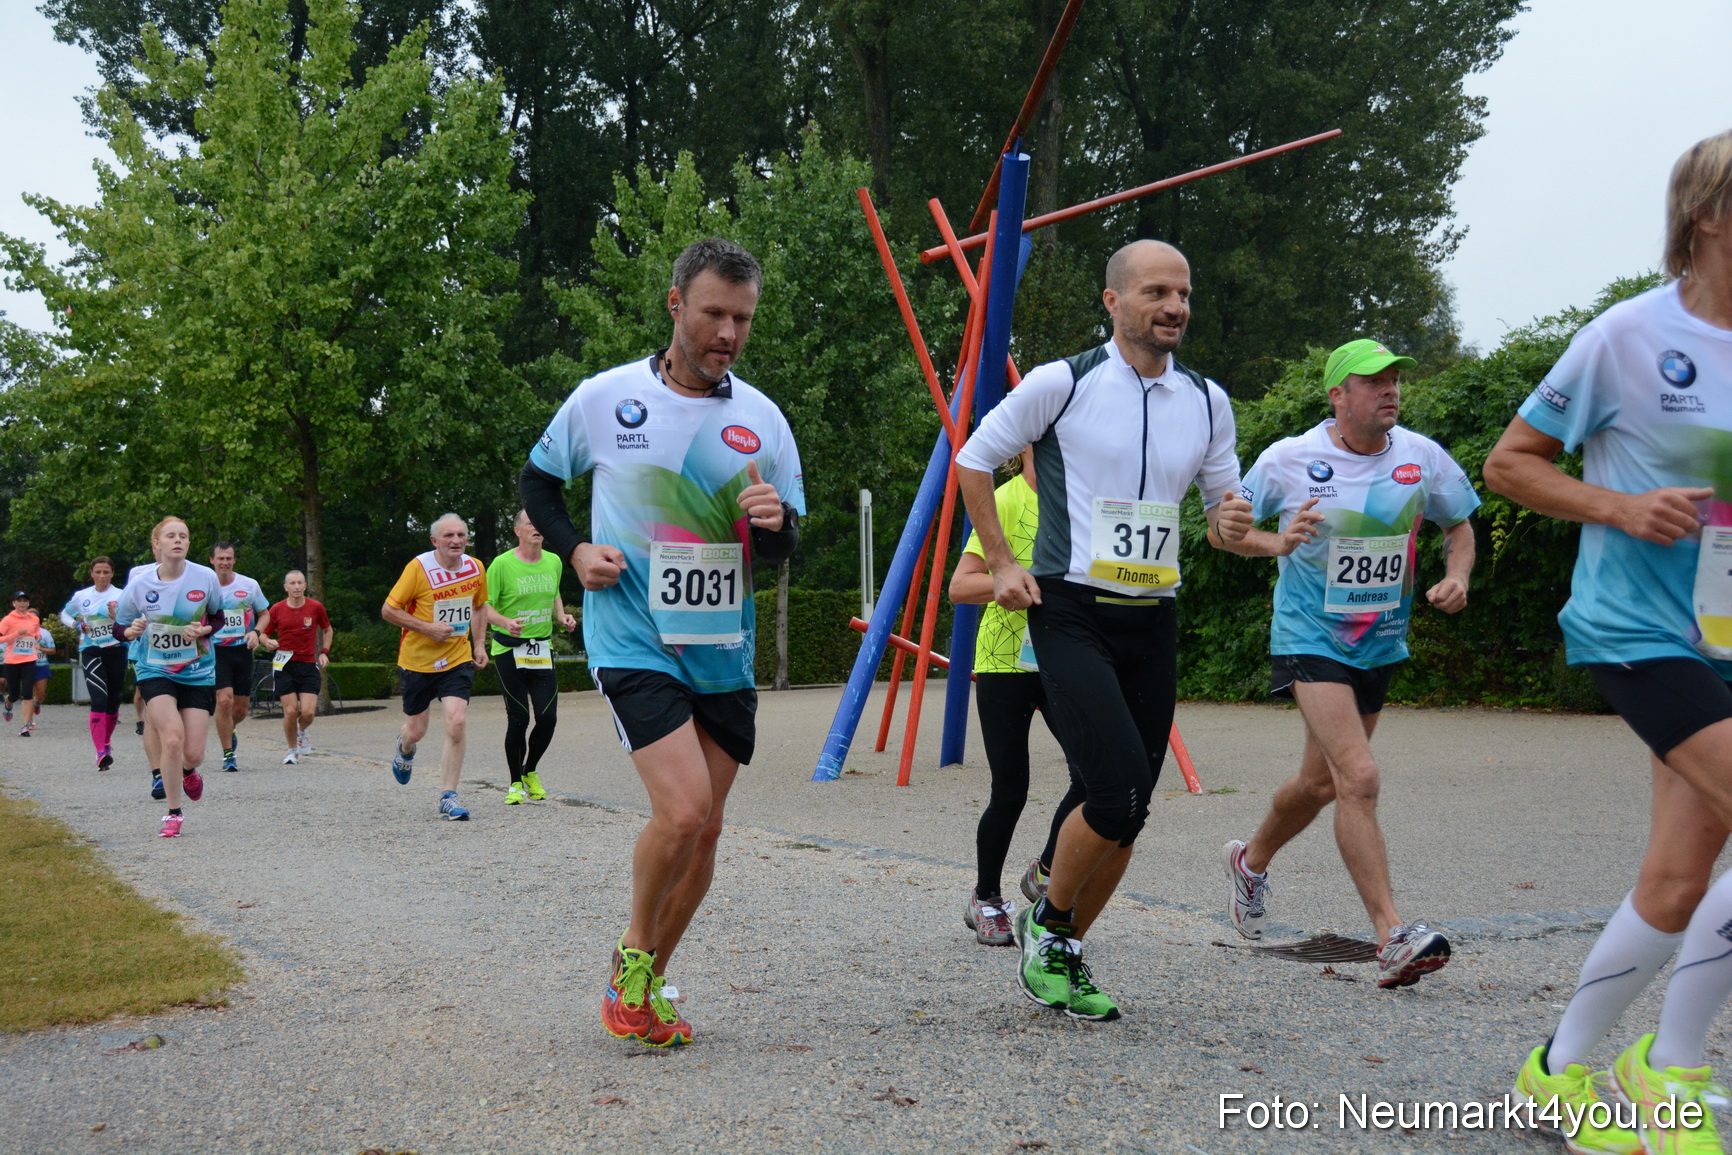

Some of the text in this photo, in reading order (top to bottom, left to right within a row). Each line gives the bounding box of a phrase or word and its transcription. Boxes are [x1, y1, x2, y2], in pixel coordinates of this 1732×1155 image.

[1660, 394, 1703, 406] PARTL
[1661, 404, 1706, 414] Neumarkt
[617, 434, 649, 443] PARTL
[728, 430, 757, 448] Hervis
[1396, 469, 1420, 479] Hervis
[1101, 509, 1133, 517] NeuerMarkt
[1140, 504, 1180, 519] BOCK
[1113, 523, 1171, 560] 317
[1369, 540, 1405, 550] BOCK
[701, 547, 738, 560] BOCK
[1337, 554, 1402, 584] 2849
[516, 574, 553, 585] NOVINA
[1116, 567, 1160, 584] Thomas
[433, 580, 481, 600] MAX BÖGL
[519, 584, 555, 595] HOTELS
[661, 568, 735, 606] 3031
[1347, 592, 1388, 603] Andreas
[438, 606, 471, 623] 2716
[224, 616, 242, 627] 493
[15, 640, 33, 649] 2319
[526, 642, 540, 656] 20
[162, 651, 182, 660] Sarah
